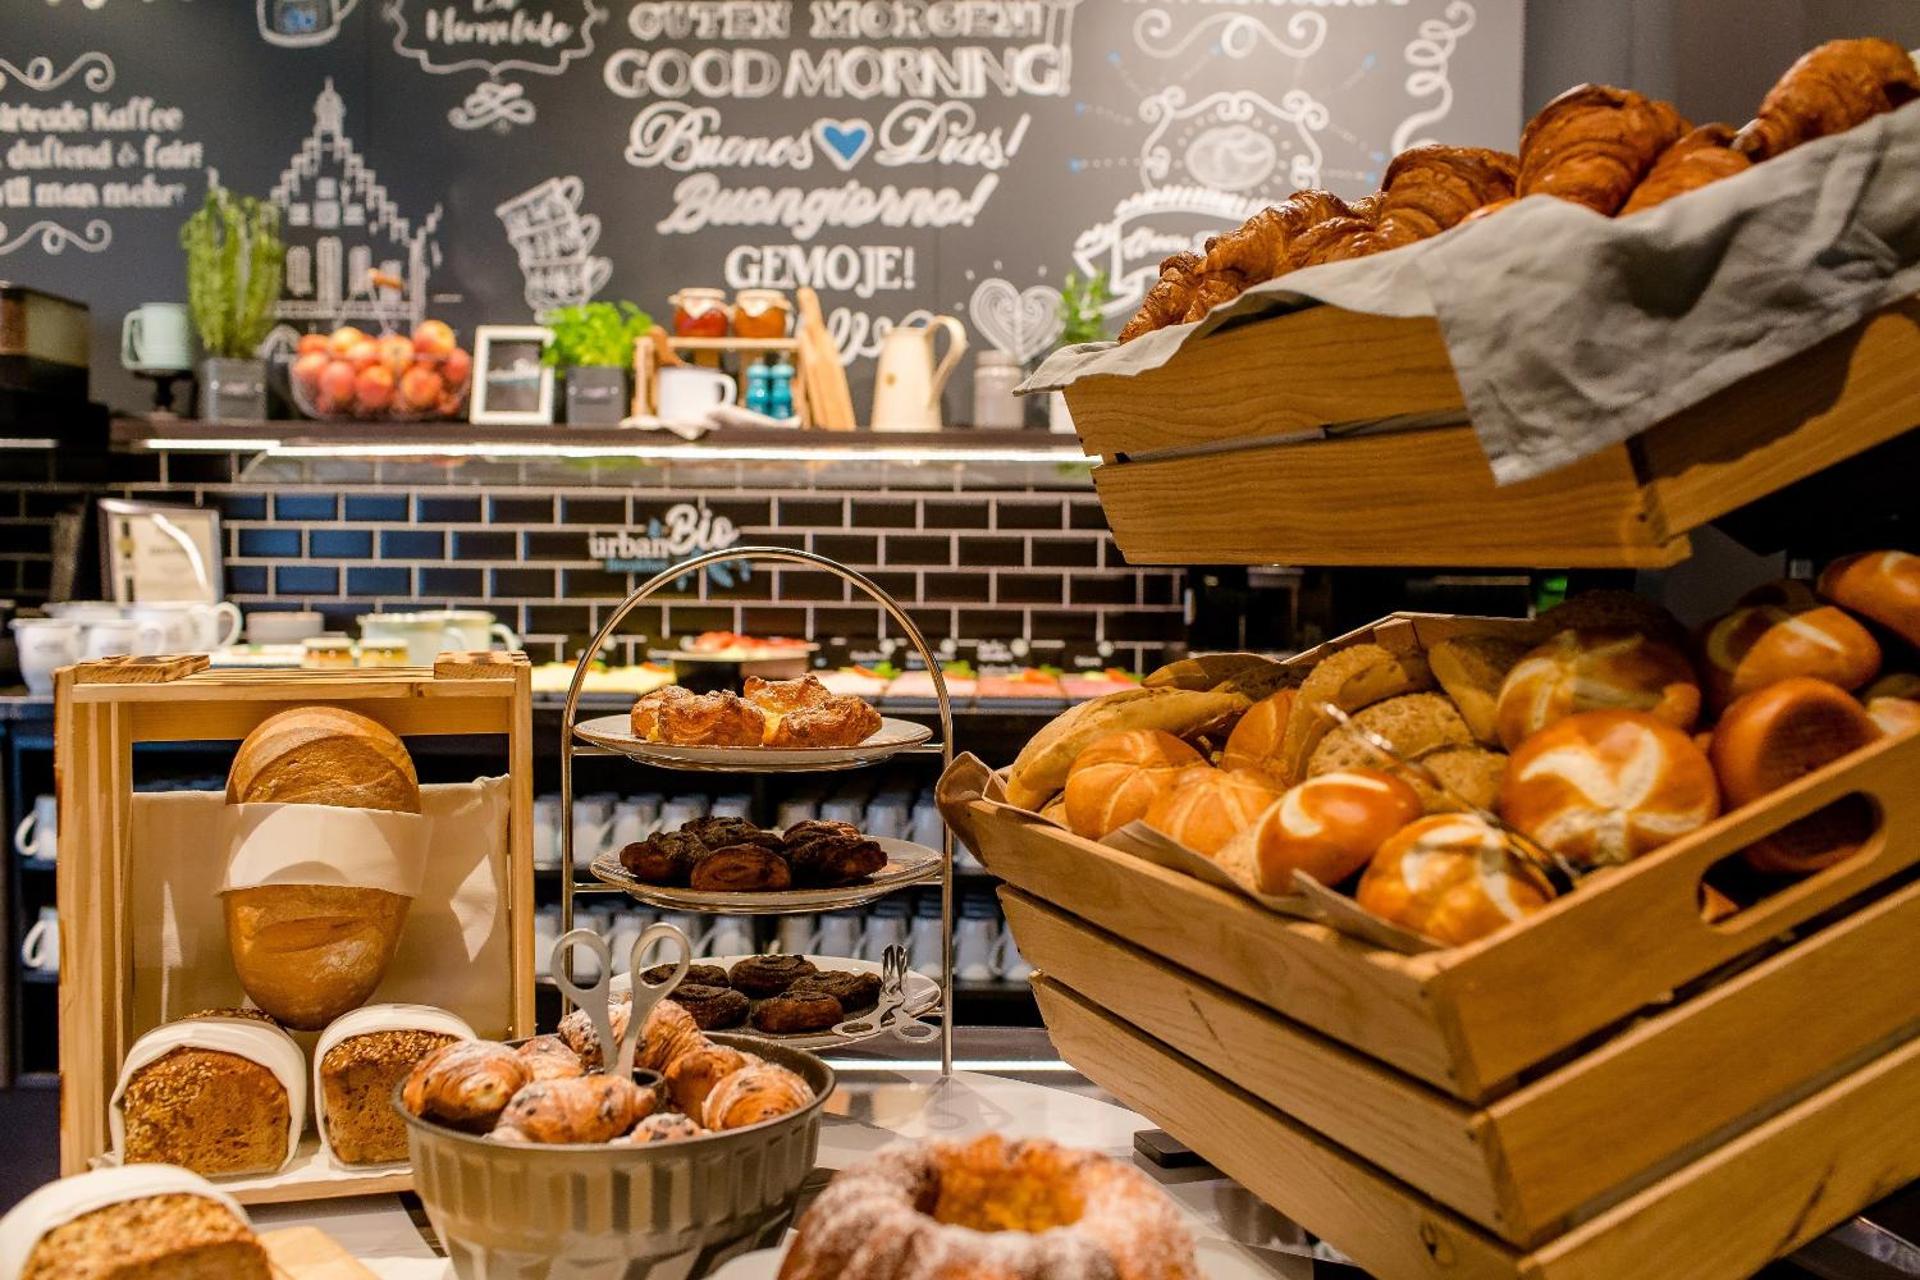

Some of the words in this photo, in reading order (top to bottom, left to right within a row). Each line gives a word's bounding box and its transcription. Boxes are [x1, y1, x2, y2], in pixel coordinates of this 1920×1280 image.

[604, 47, 782, 98] GOOD
[91, 97, 183, 132] Kaffee
[35, 183, 99, 208] man
[725, 244, 916, 298] GEMOJE!
